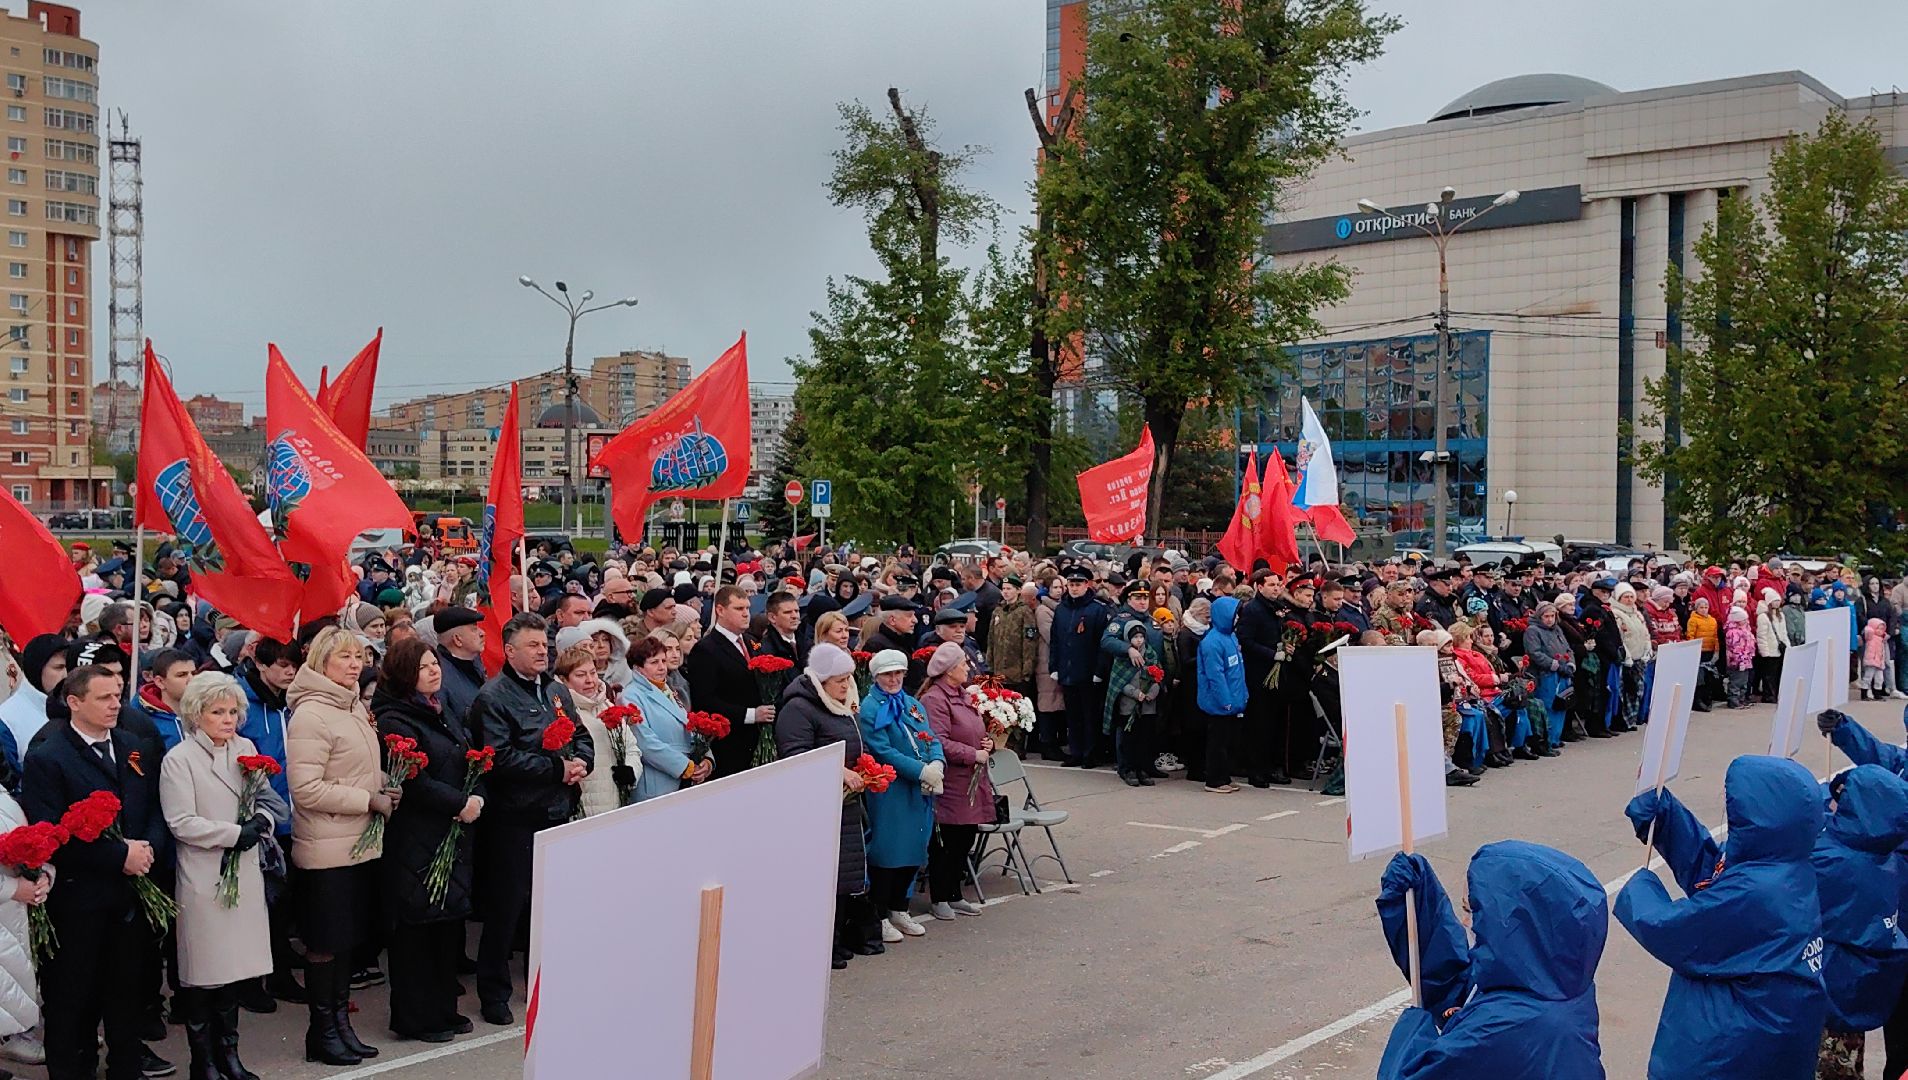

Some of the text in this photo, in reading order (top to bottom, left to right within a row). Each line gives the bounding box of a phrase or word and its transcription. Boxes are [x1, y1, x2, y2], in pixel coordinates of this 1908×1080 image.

[1355, 206, 1477, 235] открытие БАНК
[816, 483, 827, 502] P
[1882, 909, 1899, 929] ВО
